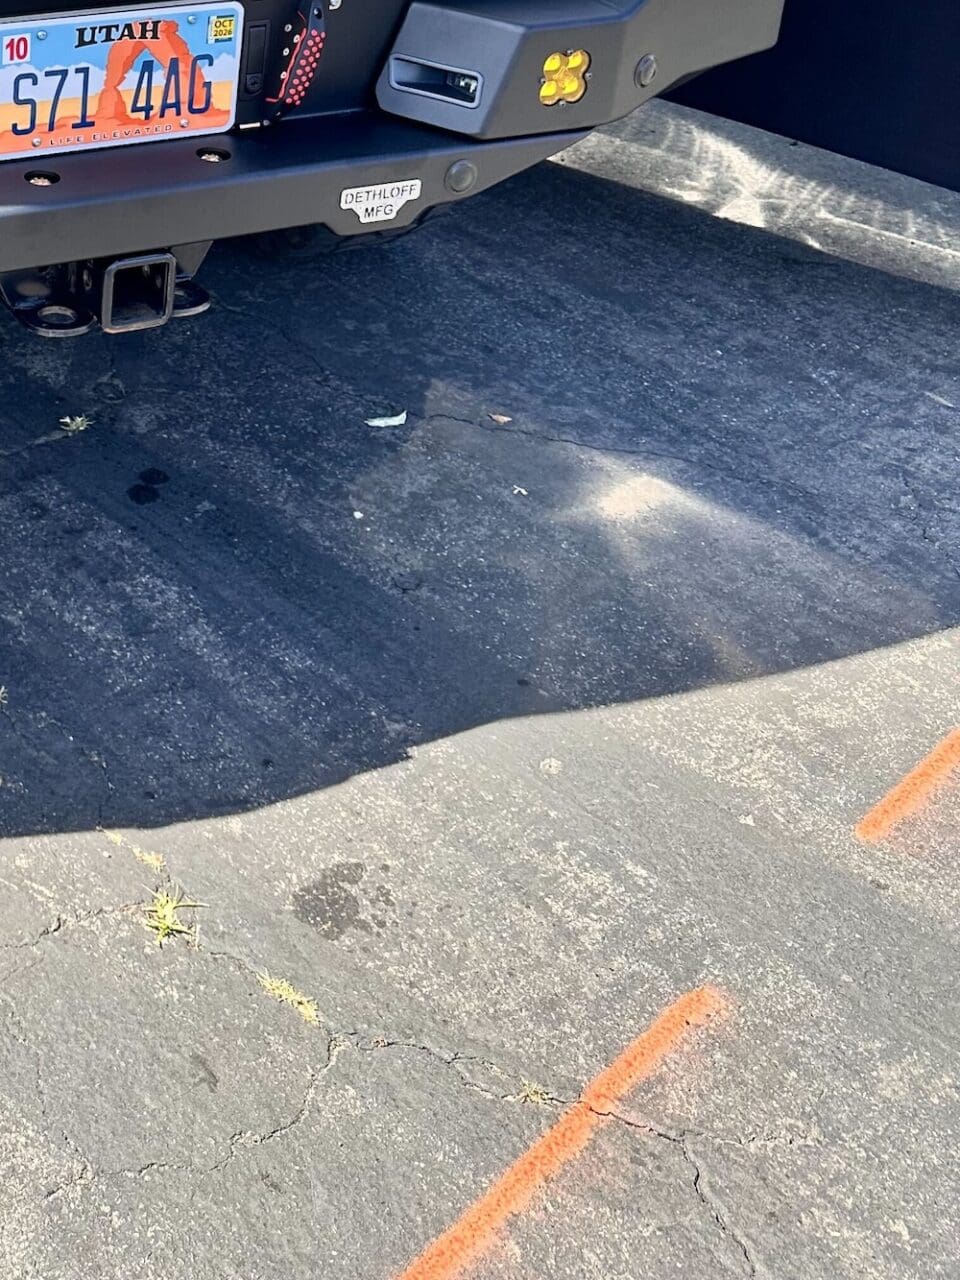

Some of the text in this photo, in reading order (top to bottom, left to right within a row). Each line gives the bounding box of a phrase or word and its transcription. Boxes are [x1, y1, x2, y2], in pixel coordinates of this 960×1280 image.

[74, 20, 162, 48] UTAH
[214, 19, 234, 28] OCT
[5, 37, 29, 61] 10
[11, 53, 214, 136] S71 4AG
[50, 124, 172, 145] LIFE ELEVATED
[344, 183, 417, 205] DETHLOFF
[363, 204, 394, 219] MFG
